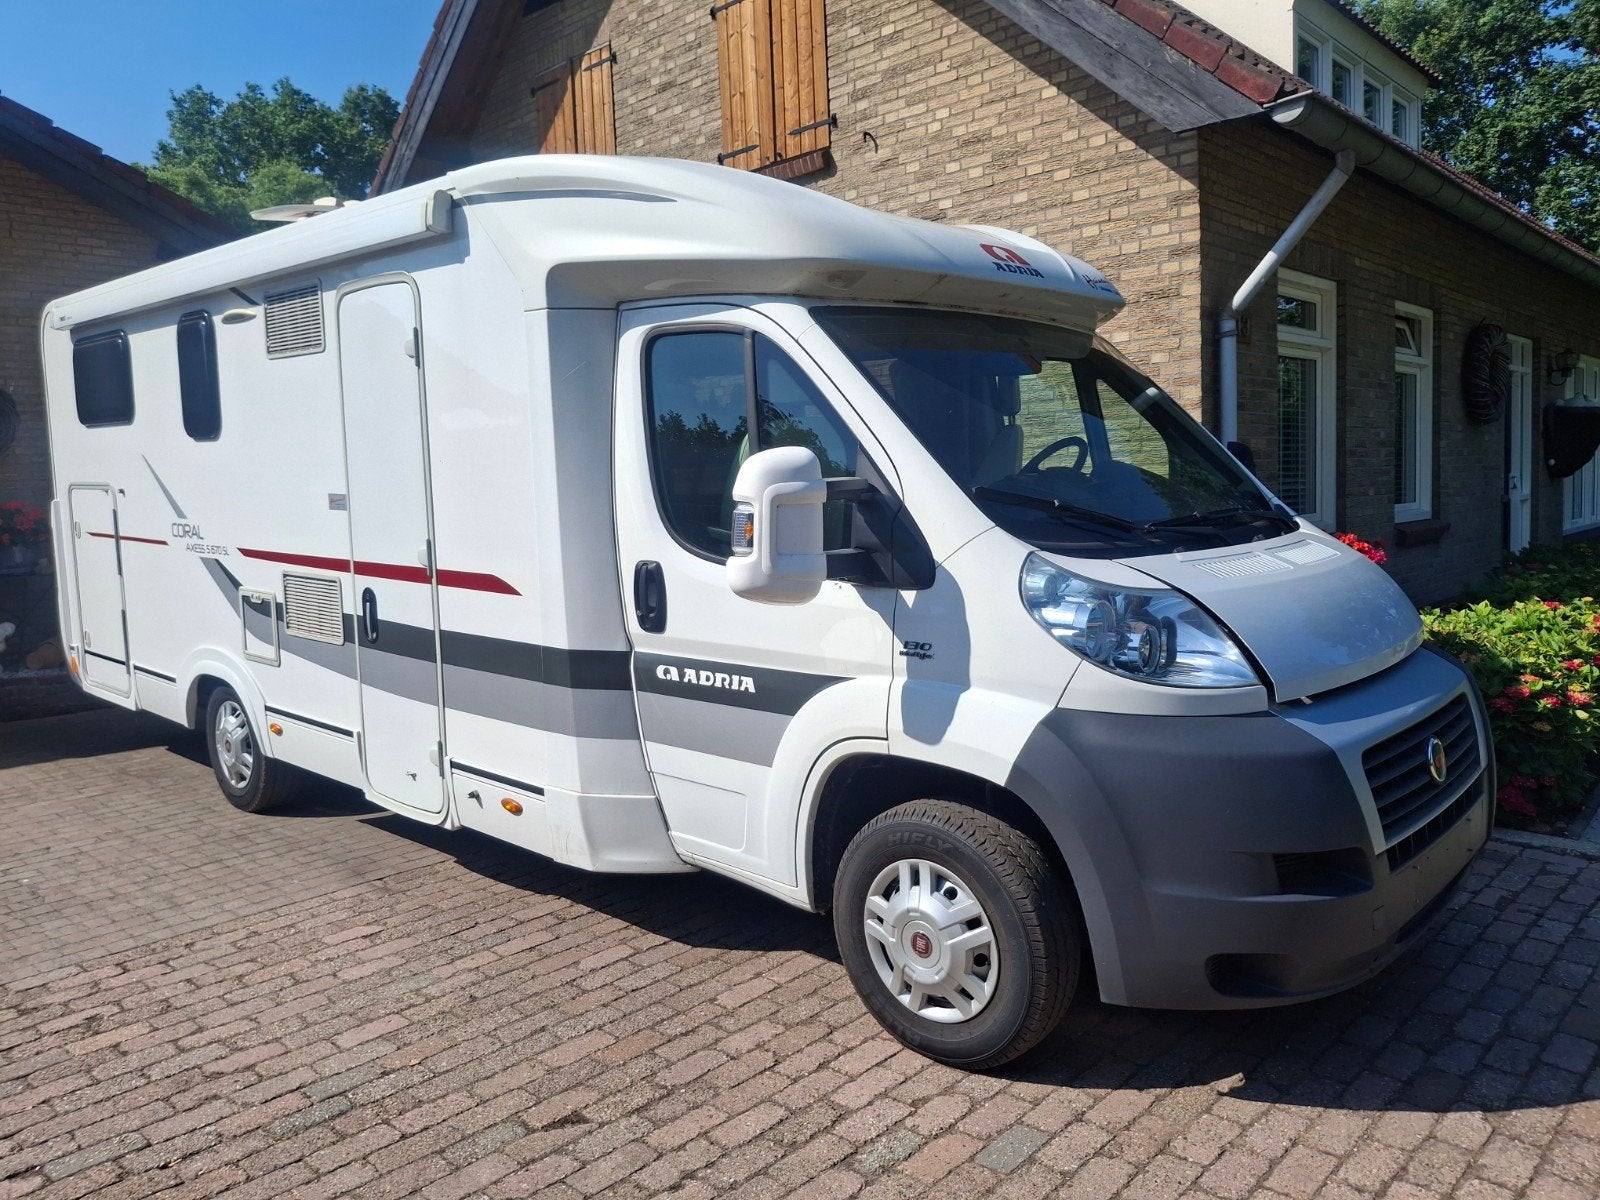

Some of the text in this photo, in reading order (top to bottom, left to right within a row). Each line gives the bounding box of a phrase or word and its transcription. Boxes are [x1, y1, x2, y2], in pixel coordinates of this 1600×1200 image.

[992, 261, 1045, 279] ADRIA
[171, 522, 204, 540] CORAL
[903, 640, 933, 651] 130
[683, 667, 756, 693] ADRIA
[887, 831, 955, 852] HIFLY
